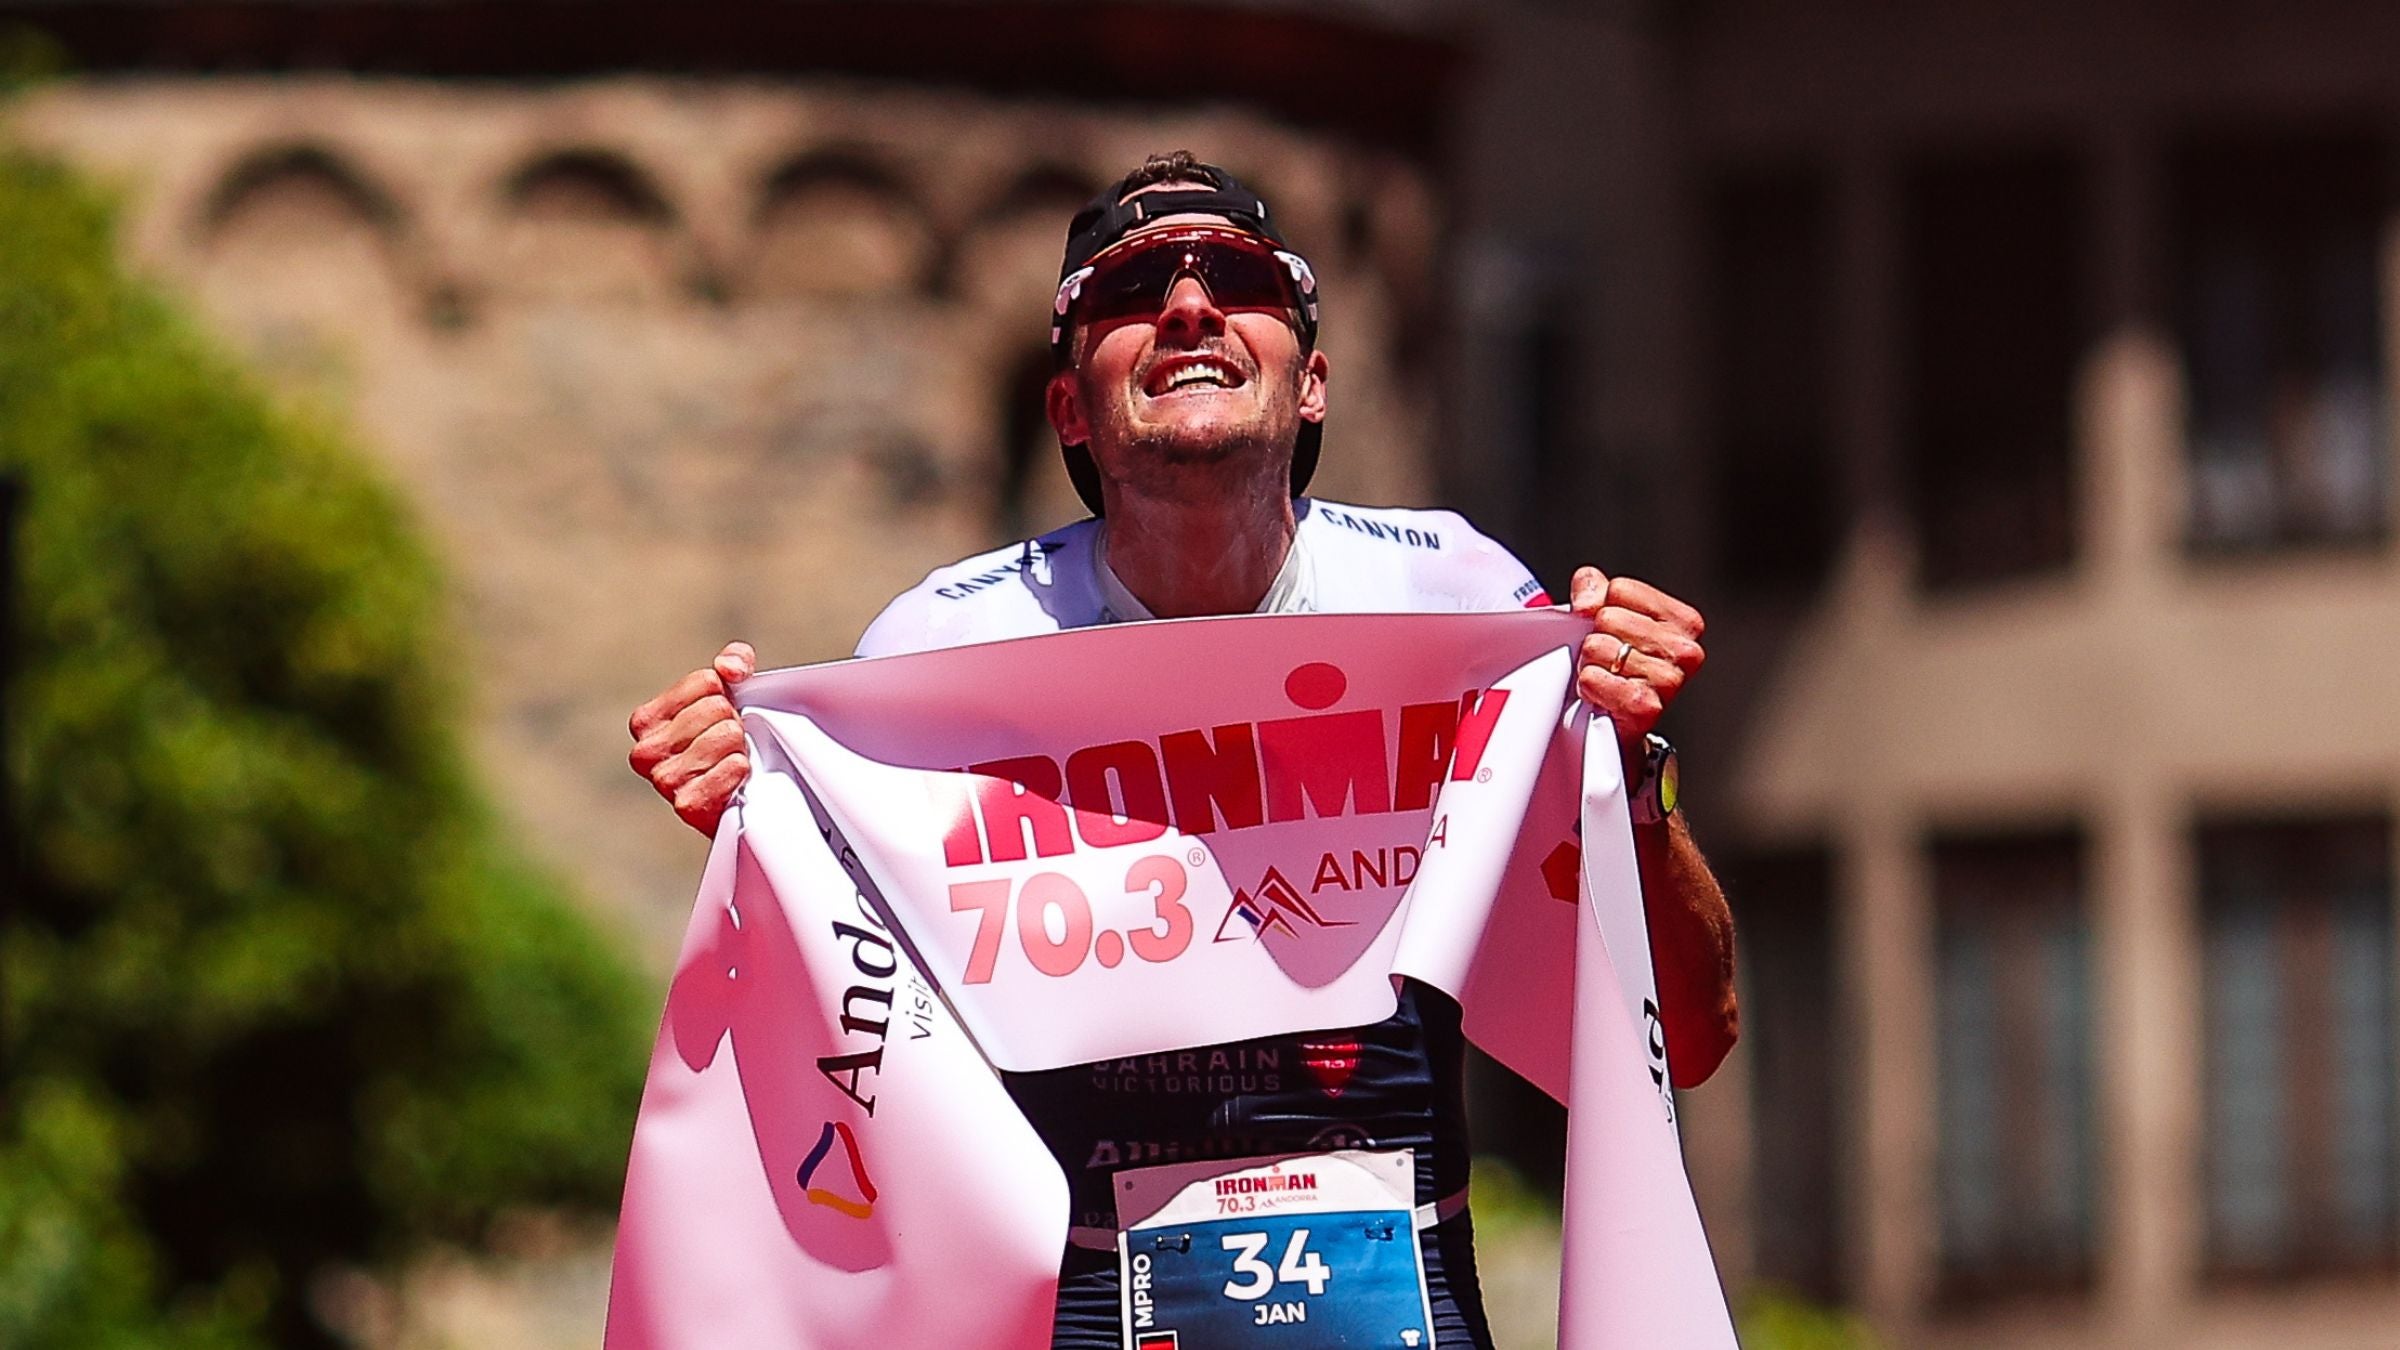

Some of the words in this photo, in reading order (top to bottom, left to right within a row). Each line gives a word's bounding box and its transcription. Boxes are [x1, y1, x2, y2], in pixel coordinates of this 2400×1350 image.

[1320, 508, 1440, 550] CANYON
[942, 676, 1512, 868] IRONMAN
[948, 854, 1195, 986] 70.3
[1215, 1166, 1318, 1196] IRONMAN
[1216, 1196, 1256, 1214] 70.3
[1132, 1253, 1154, 1328] MPRO
[1221, 1229, 1332, 1301] 34
[1253, 1302, 1307, 1326] JAN
